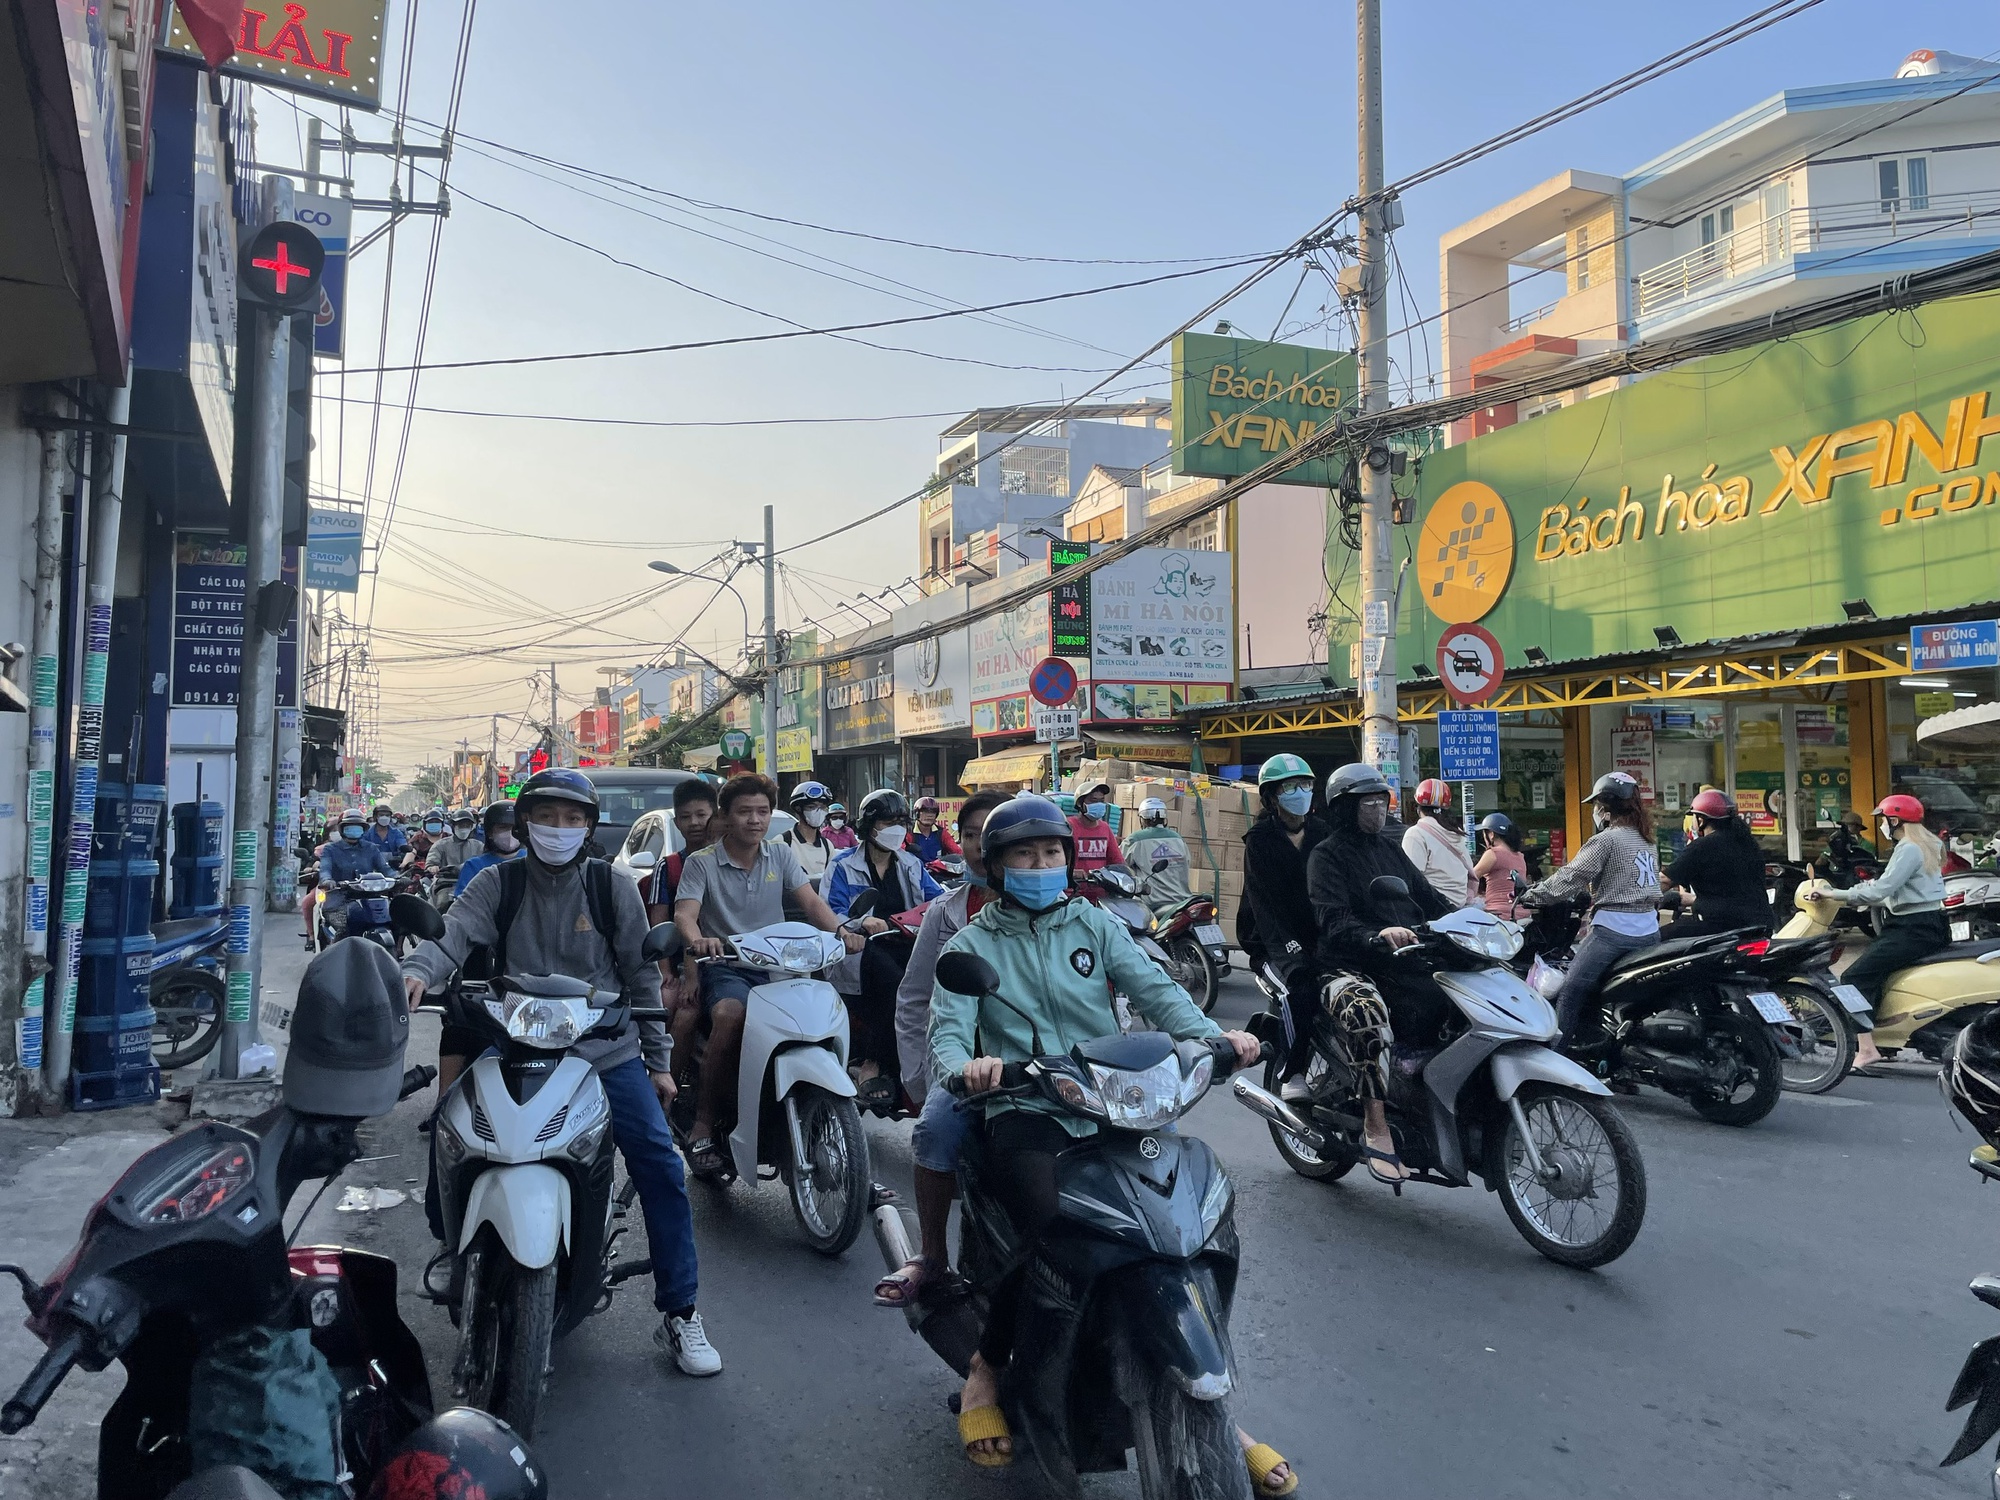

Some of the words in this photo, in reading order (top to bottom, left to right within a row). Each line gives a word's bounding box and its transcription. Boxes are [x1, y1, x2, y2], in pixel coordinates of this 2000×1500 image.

[1208, 364, 1284, 402] Bách
[1288, 372, 1341, 408] hóa
[1534, 497, 1645, 562] Bách
[1654, 463, 1753, 537] hóa
[200, 576, 221, 587] CÁC
[226, 578, 246, 590] LOẠ
[1097, 576, 1136, 597] BÁNH
[1062, 585, 1079, 598] HÀ
[1060, 600, 1082, 619] NỘI
[1103, 601, 1131, 620] MÌ
[1140, 599, 1174, 621] HÀ
[1182, 601, 1225, 626] NỘI
[1932, 627, 1978, 642] ĐƯỜNG
[193, 645, 223, 658] NHẬN
[1914, 645, 1946, 660] PHAN
[1949, 641, 1970, 658] VĂN
[1364, 654, 1377, 663] 80
[189, 662, 211, 673] CÁC
[184, 691, 219, 703] 0914
[81, 710, 102, 726] 355
[1451, 712, 1467, 722] ÔTÔ
[1468, 713, 1484, 722] CON
[80, 726, 101, 741] 766
[1441, 724, 1460, 734] ĐƯỢC
[1460, 723, 1474, 733] LƯU
[1475, 722, 1496, 732] THÔNG
[1446, 734, 1456, 745] TỪ
[1458, 736, 1467, 745] 21
[1483, 736, 1492, 744] 00
[78, 742, 100, 760] 0932
[1443, 745, 1460, 756] ĐẾN
[1461, 747, 1467, 756] 5
[1468, 745, 1481, 755] GIỜ
[1454, 758, 1465, 767] XE
[1466, 756, 1486, 767] BUÝT
[1463, 768, 1477, 777] LƯU
[1478, 767, 1498, 777] THÔNG
